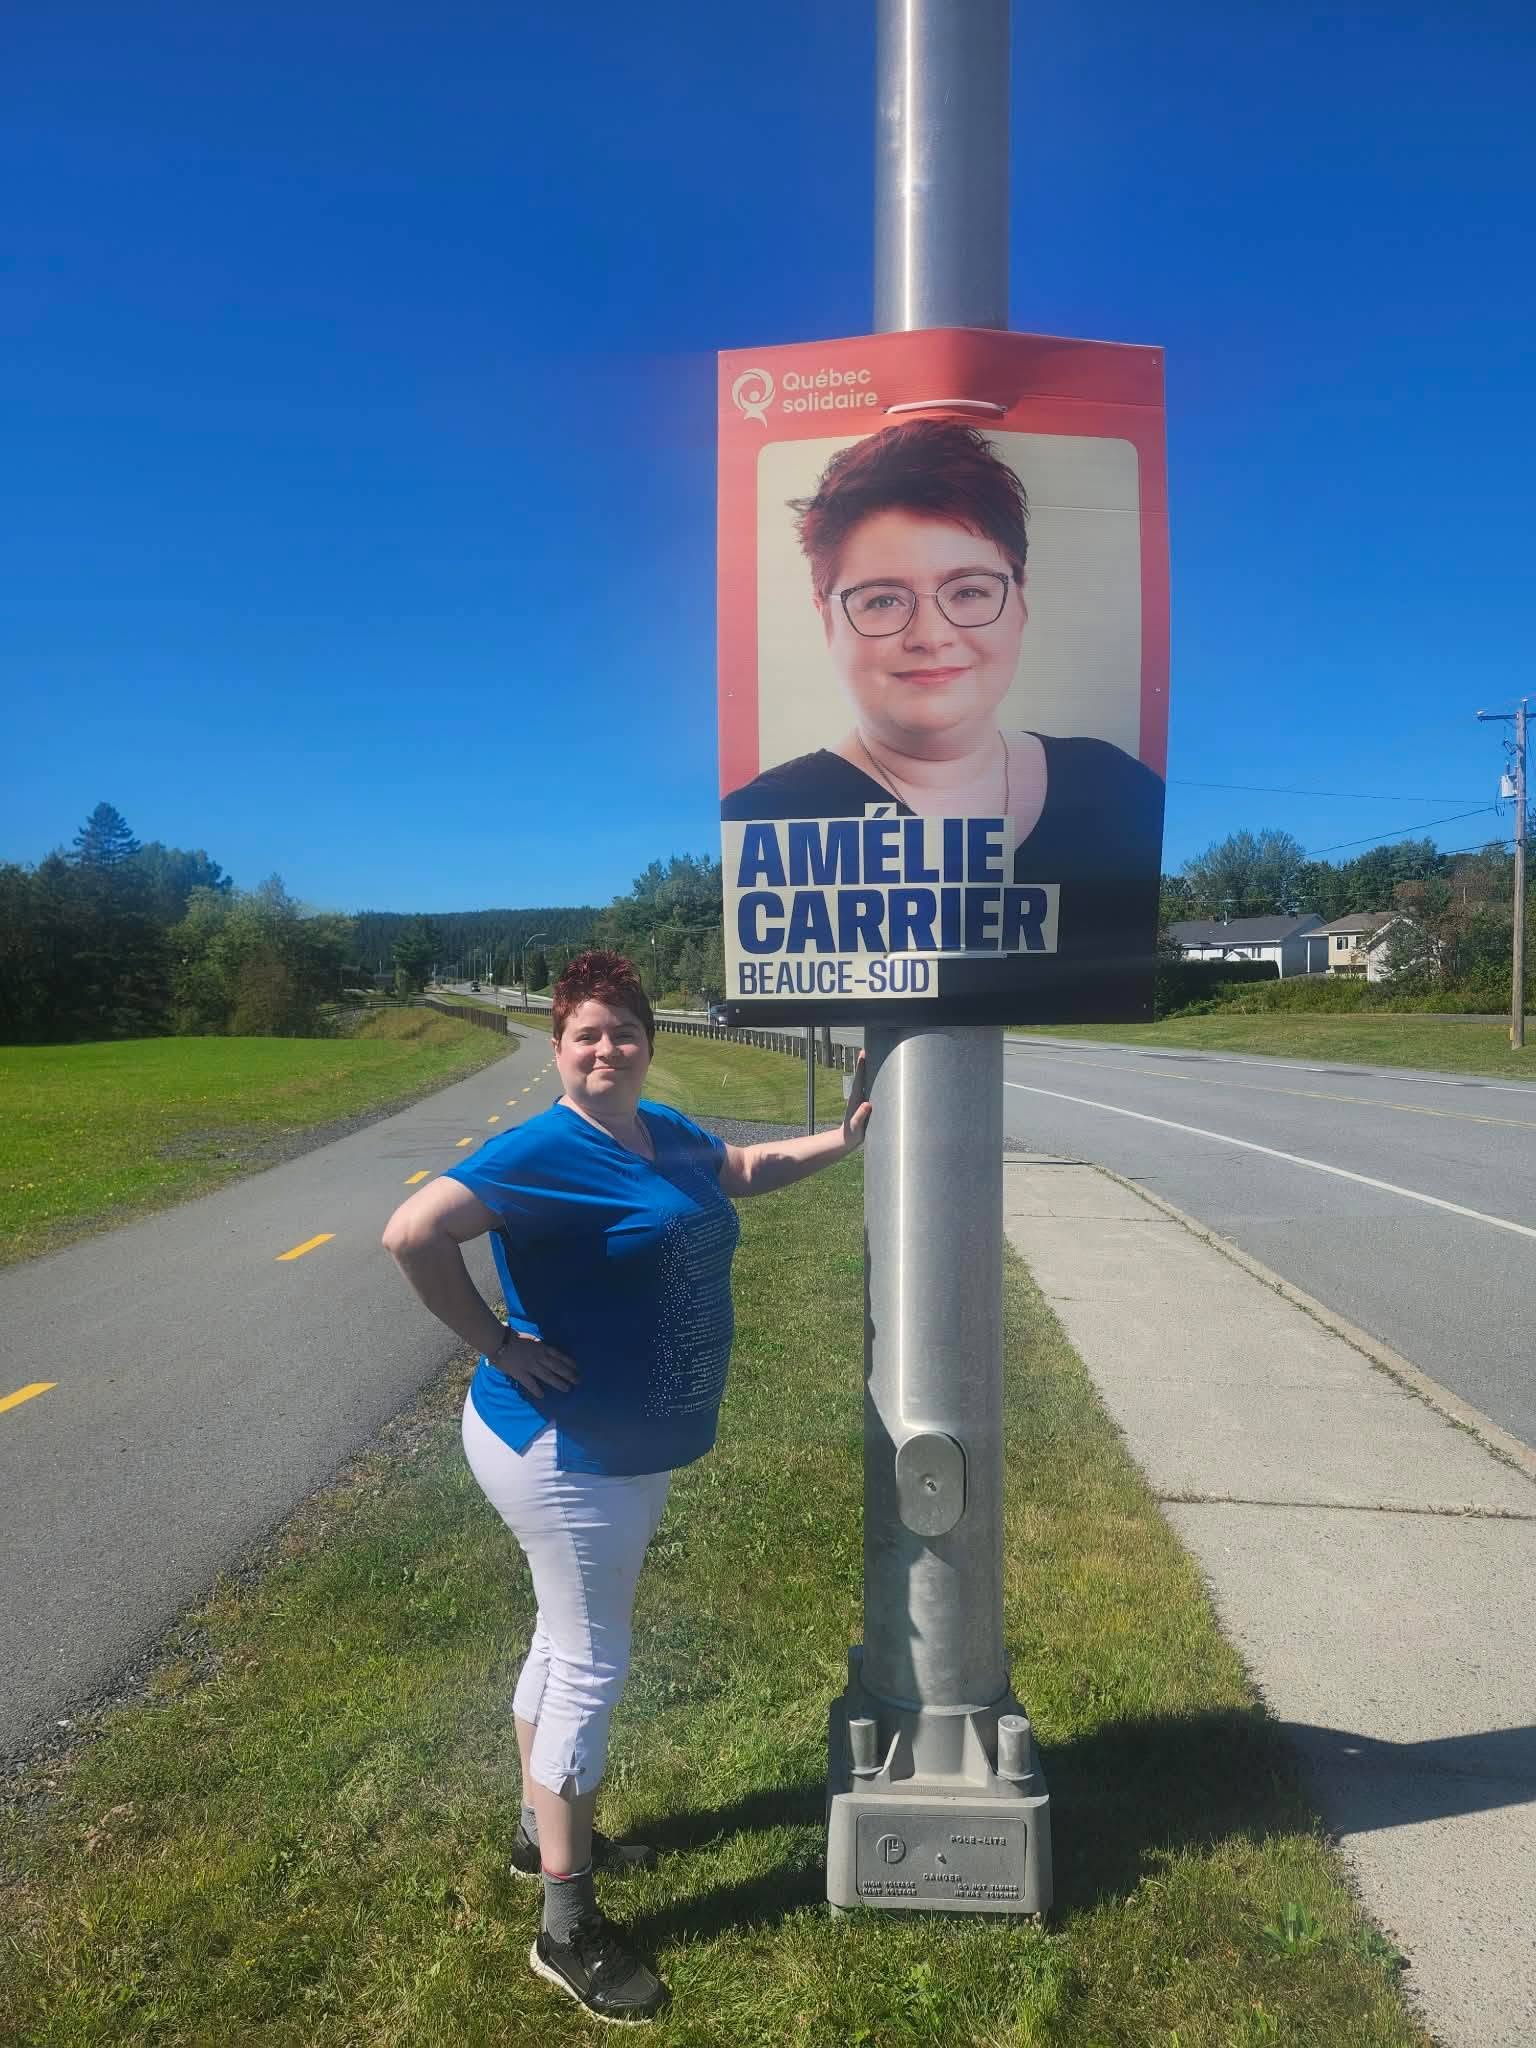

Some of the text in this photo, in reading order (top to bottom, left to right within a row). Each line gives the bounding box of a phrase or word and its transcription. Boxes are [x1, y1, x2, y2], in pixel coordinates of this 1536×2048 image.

[782, 368, 872, 391] Québec
[783, 389, 878, 413] solidaire
[737, 807, 1005, 887] AMÉLIE
[737, 887, 1047, 954] CARRIER
[739, 959, 930, 994] BEAUCE-SUD
[950, 1835, 1007, 1847] POLE-LITE
[922, 1872, 962, 1882] DANGER
